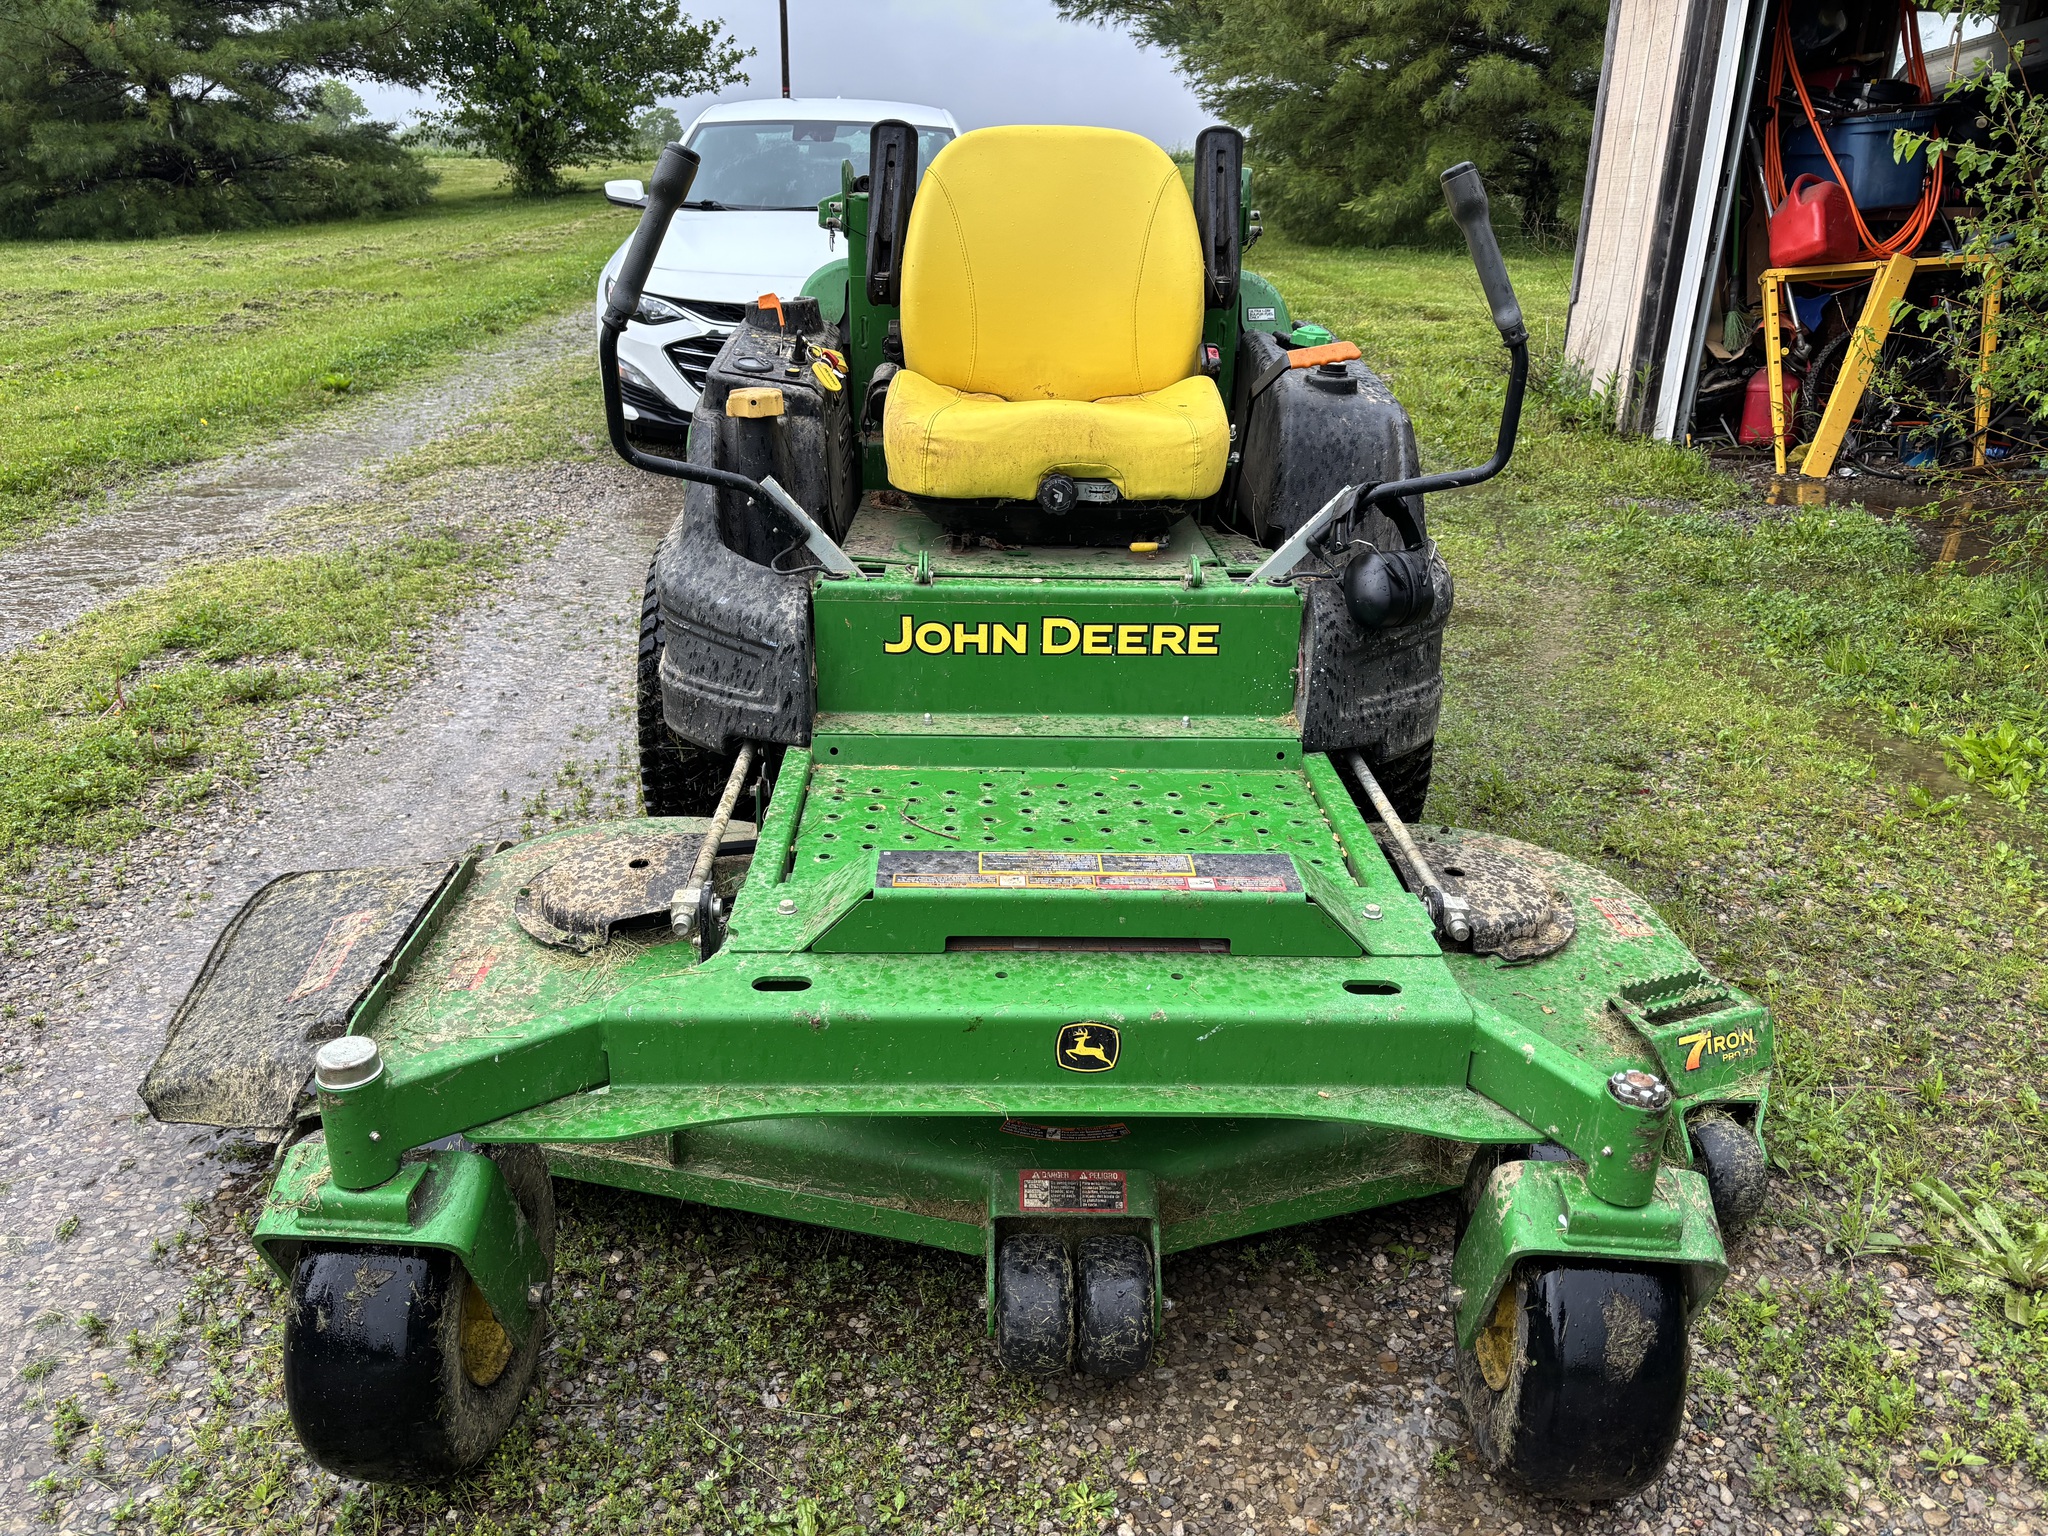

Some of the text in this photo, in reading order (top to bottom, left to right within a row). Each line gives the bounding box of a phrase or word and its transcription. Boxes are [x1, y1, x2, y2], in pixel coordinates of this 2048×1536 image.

[884, 614, 1220, 655] JOHN DEERE
[1089, 1172, 1118, 1180] PELIGRO
